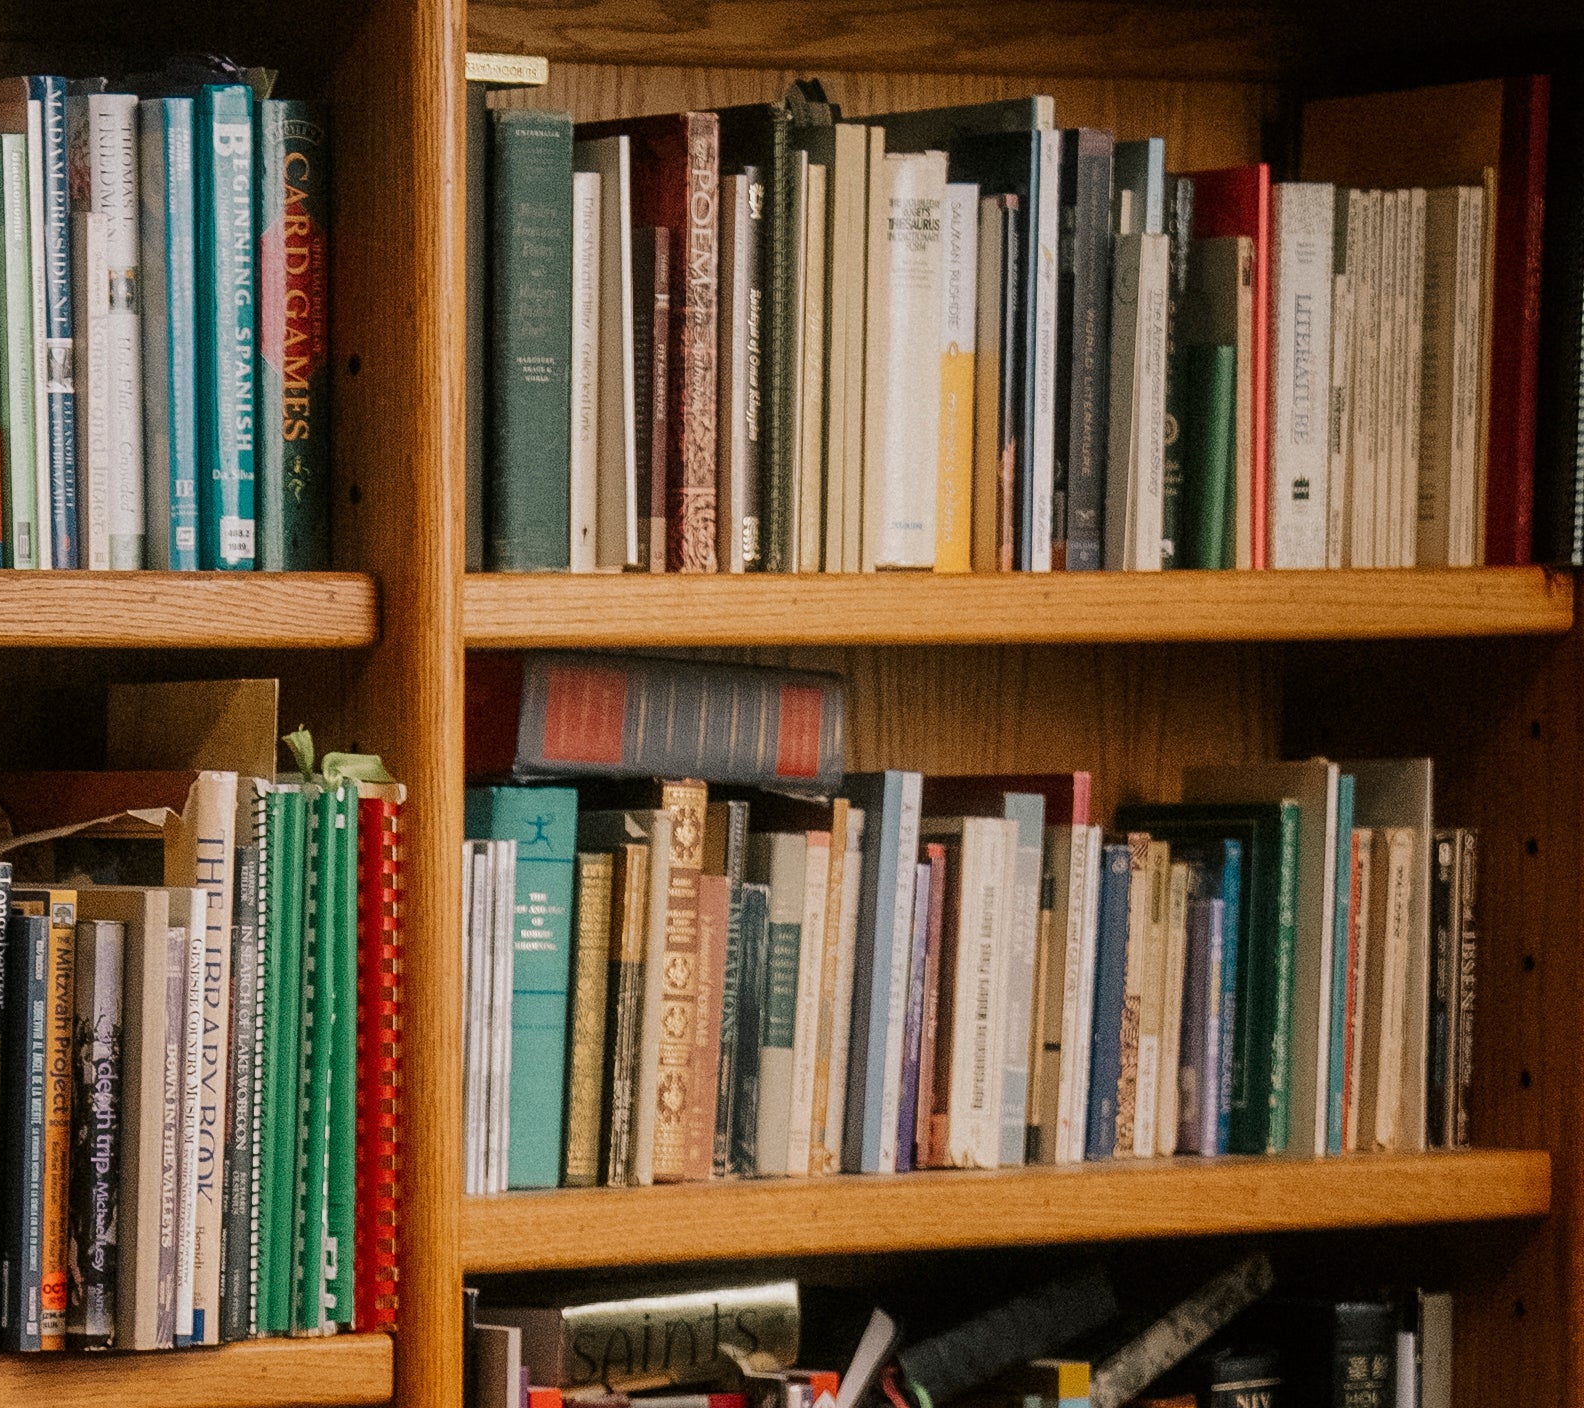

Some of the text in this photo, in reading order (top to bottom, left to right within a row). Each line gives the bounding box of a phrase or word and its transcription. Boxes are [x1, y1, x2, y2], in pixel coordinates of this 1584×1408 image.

[48, 89, 68, 328] MADAM PRESIDENT
[98, 110, 116, 244] FRIEDMAN
[213, 122, 252, 451] BEGINNING SPANISH
[282, 151, 311, 442] CARD GAMES
[948, 269, 962, 331] RUSHDIE
[1291, 293, 1312, 445] LITERATURE
[90, 314, 109, 535] Romeo and Juliet
[52, 947, 72, 1114] Mitzvah Project
[183, 938, 203, 1145] GENESEE COUNTRY MUSEUM
